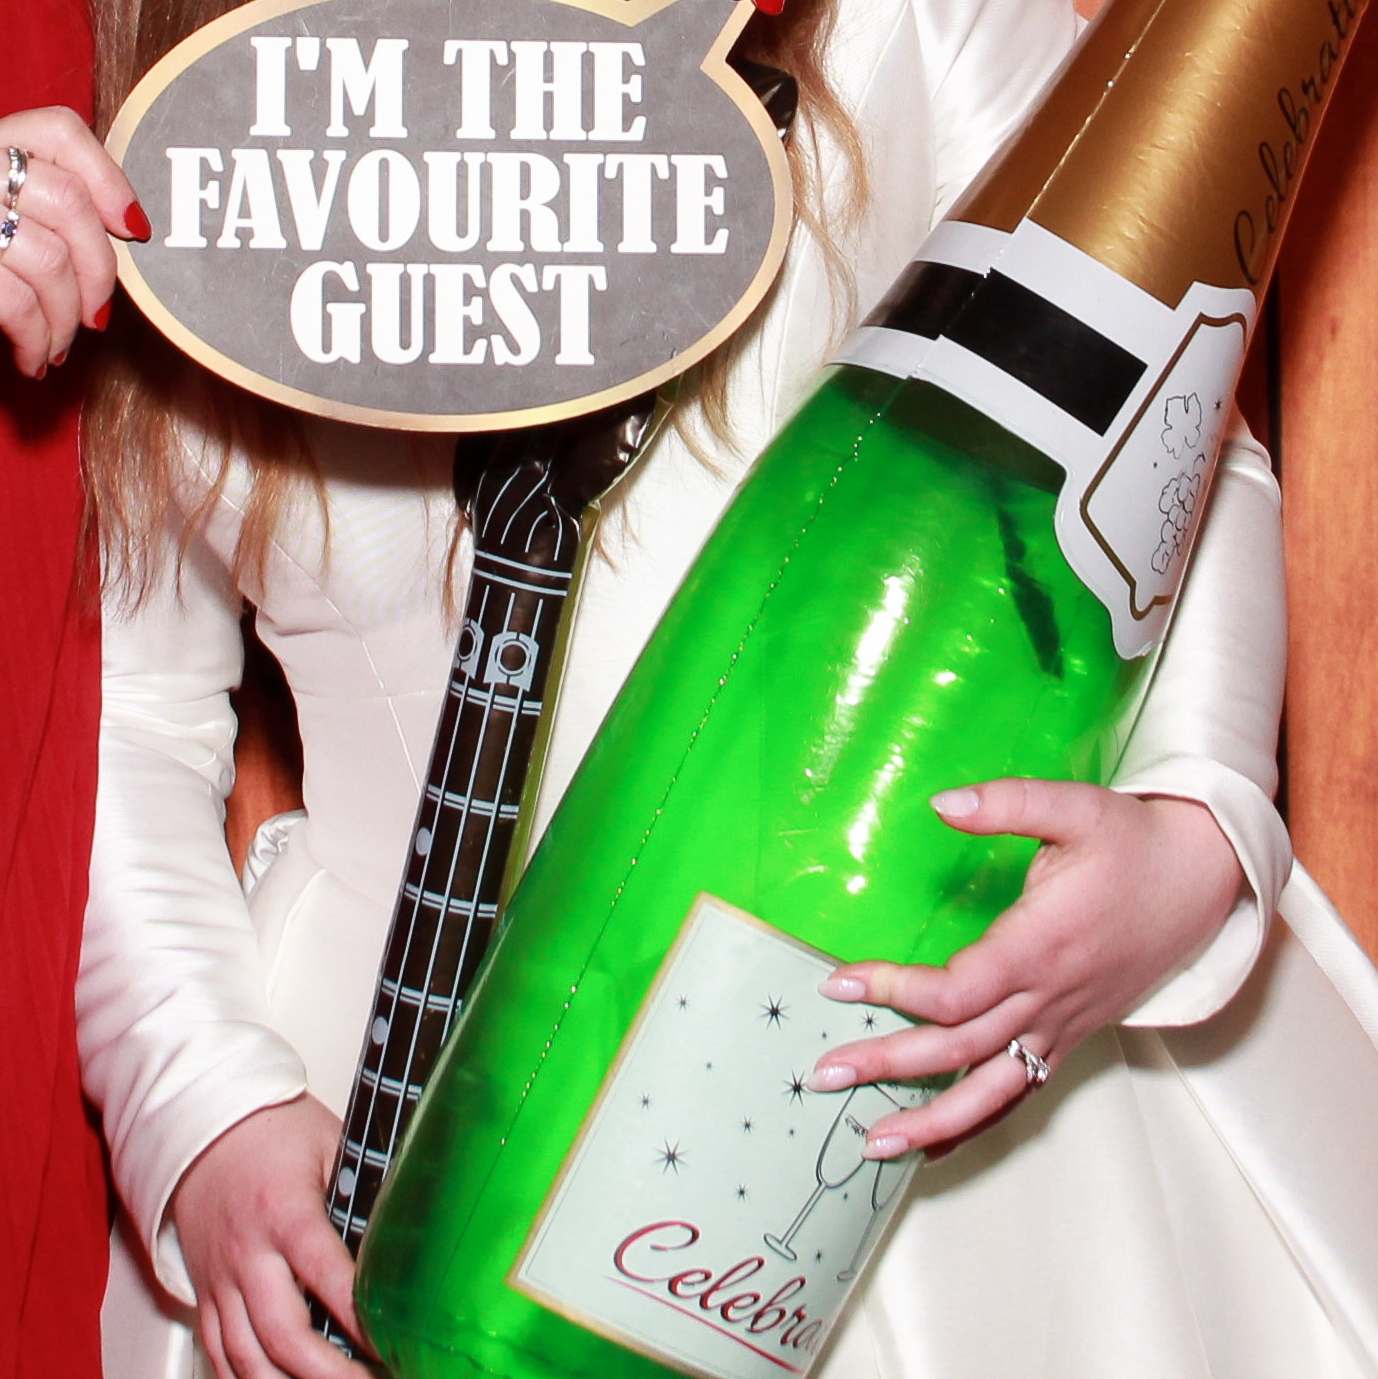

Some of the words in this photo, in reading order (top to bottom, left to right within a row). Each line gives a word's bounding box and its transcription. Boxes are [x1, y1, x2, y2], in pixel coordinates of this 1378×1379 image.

[249, 36, 409, 139] I'M
[443, 39, 647, 142] THE
[164, 147, 729, 255] FAVOURITE
[290, 260, 608, 366] GUEST
